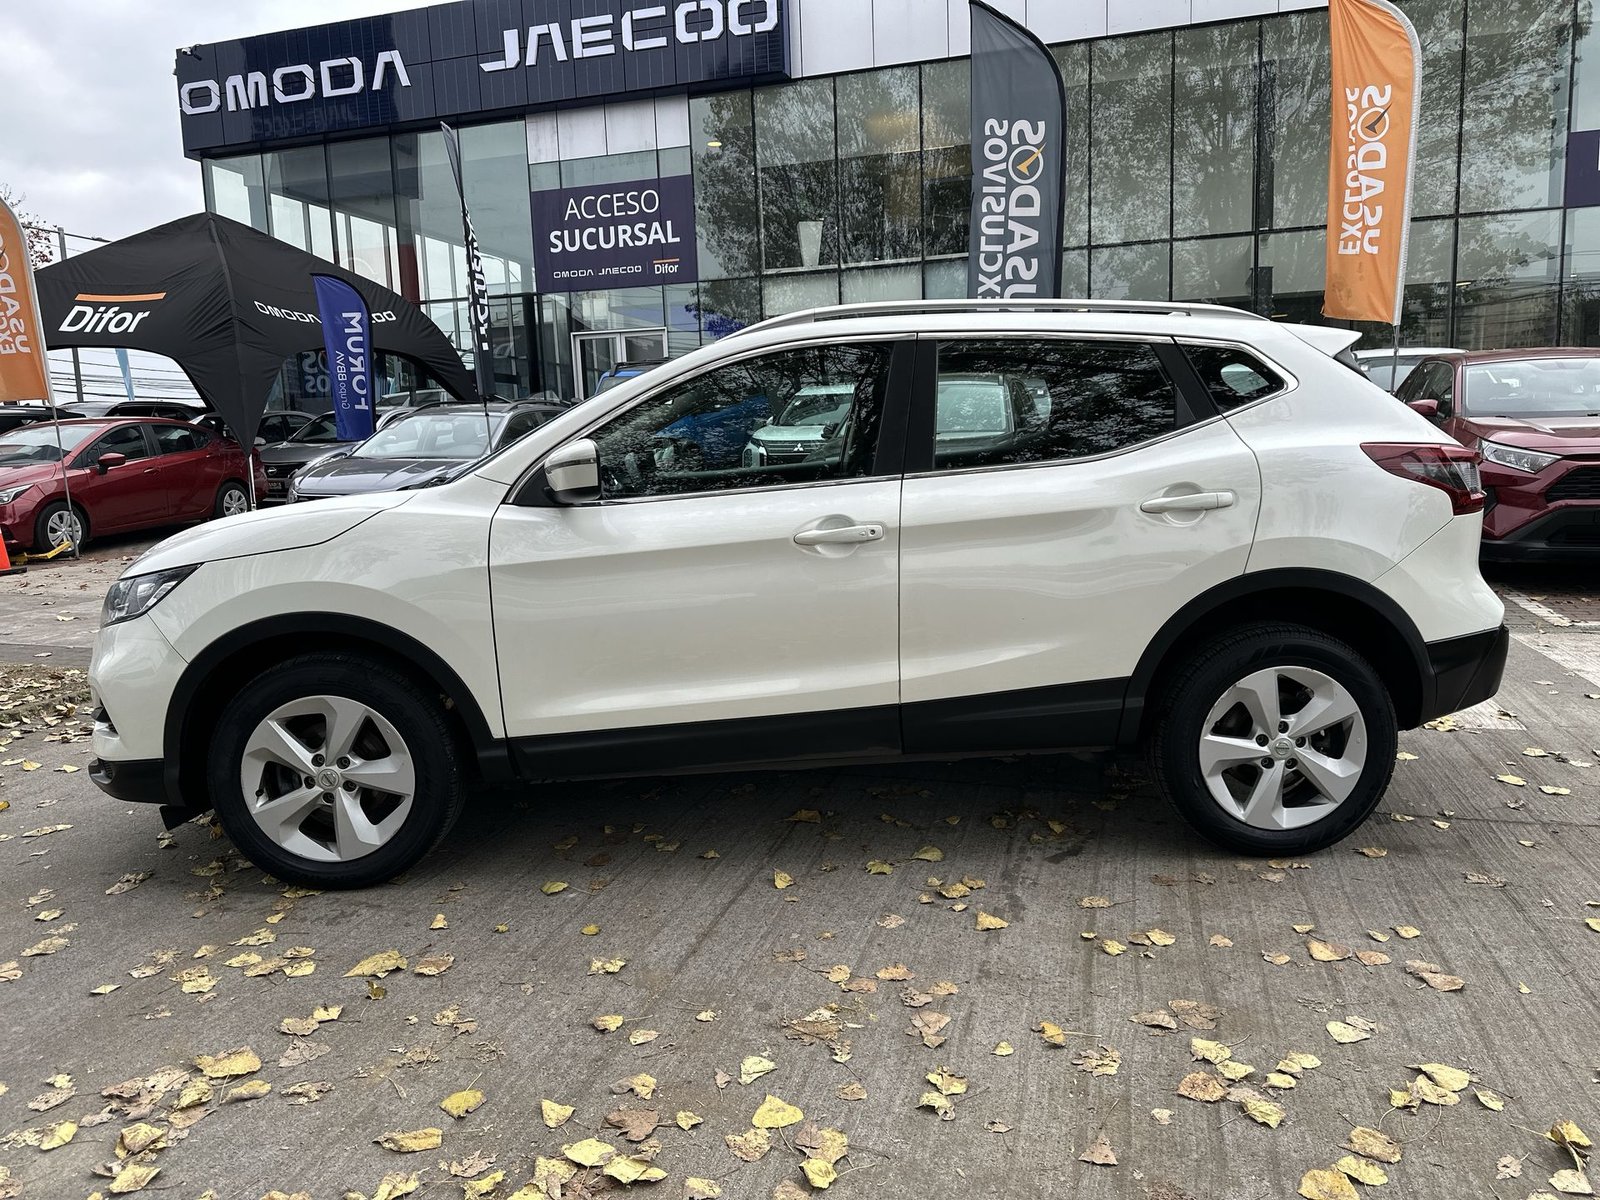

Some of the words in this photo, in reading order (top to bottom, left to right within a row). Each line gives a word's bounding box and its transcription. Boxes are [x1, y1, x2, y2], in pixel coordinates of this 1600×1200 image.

[180, 49, 412, 116] OMODA
[479, 0, 779, 72] JAECOO
[564, 189, 660, 221] ACCESO
[549, 220, 681, 253] SUCURSAL
[553, 269, 594, 279] OMODA
[598, 265, 642, 276] JAECOO
[654, 263, 679, 275] Difor
[58, 305, 151, 334] Difor
[254, 300, 323, 324] OMODA
